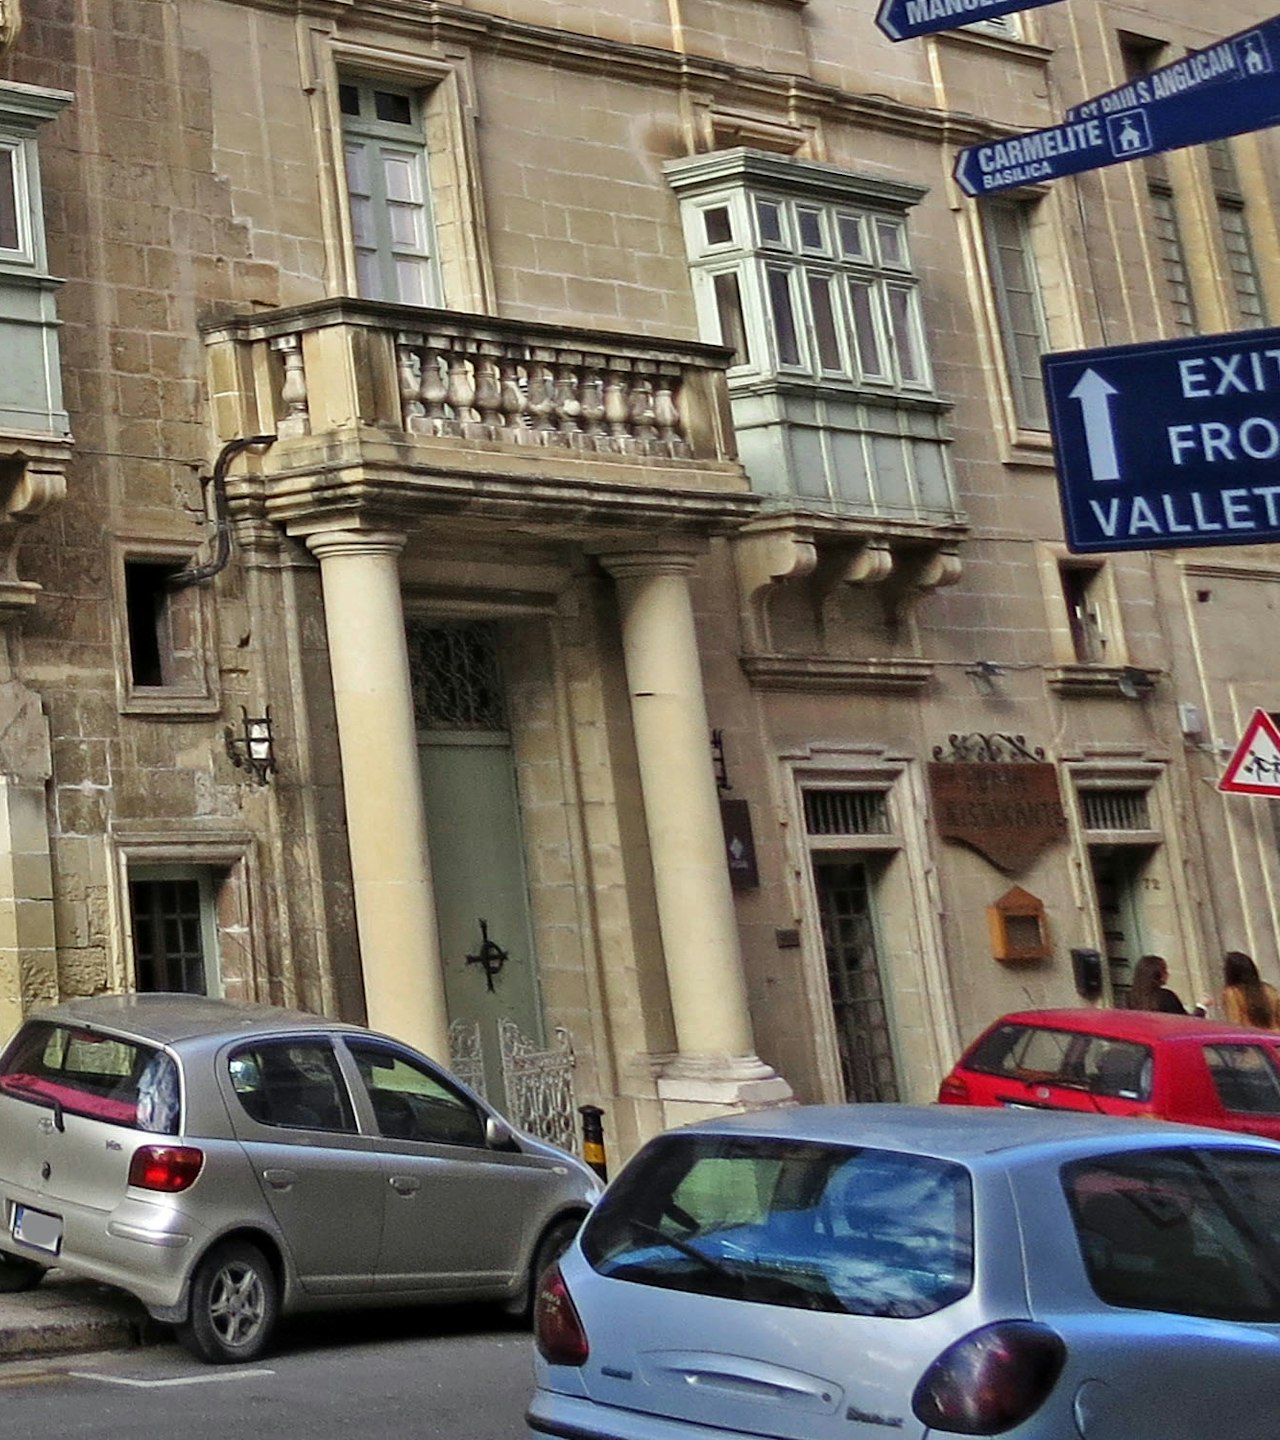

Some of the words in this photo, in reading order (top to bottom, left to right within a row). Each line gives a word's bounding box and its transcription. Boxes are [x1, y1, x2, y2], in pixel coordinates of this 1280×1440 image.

[1151, 43, 1235, 100] ANGLICAN
[977, 121, 1103, 173] CARMELITE
[983, 161, 1052, 189] BASILICA
[1167, 417, 1279, 465] FRO
